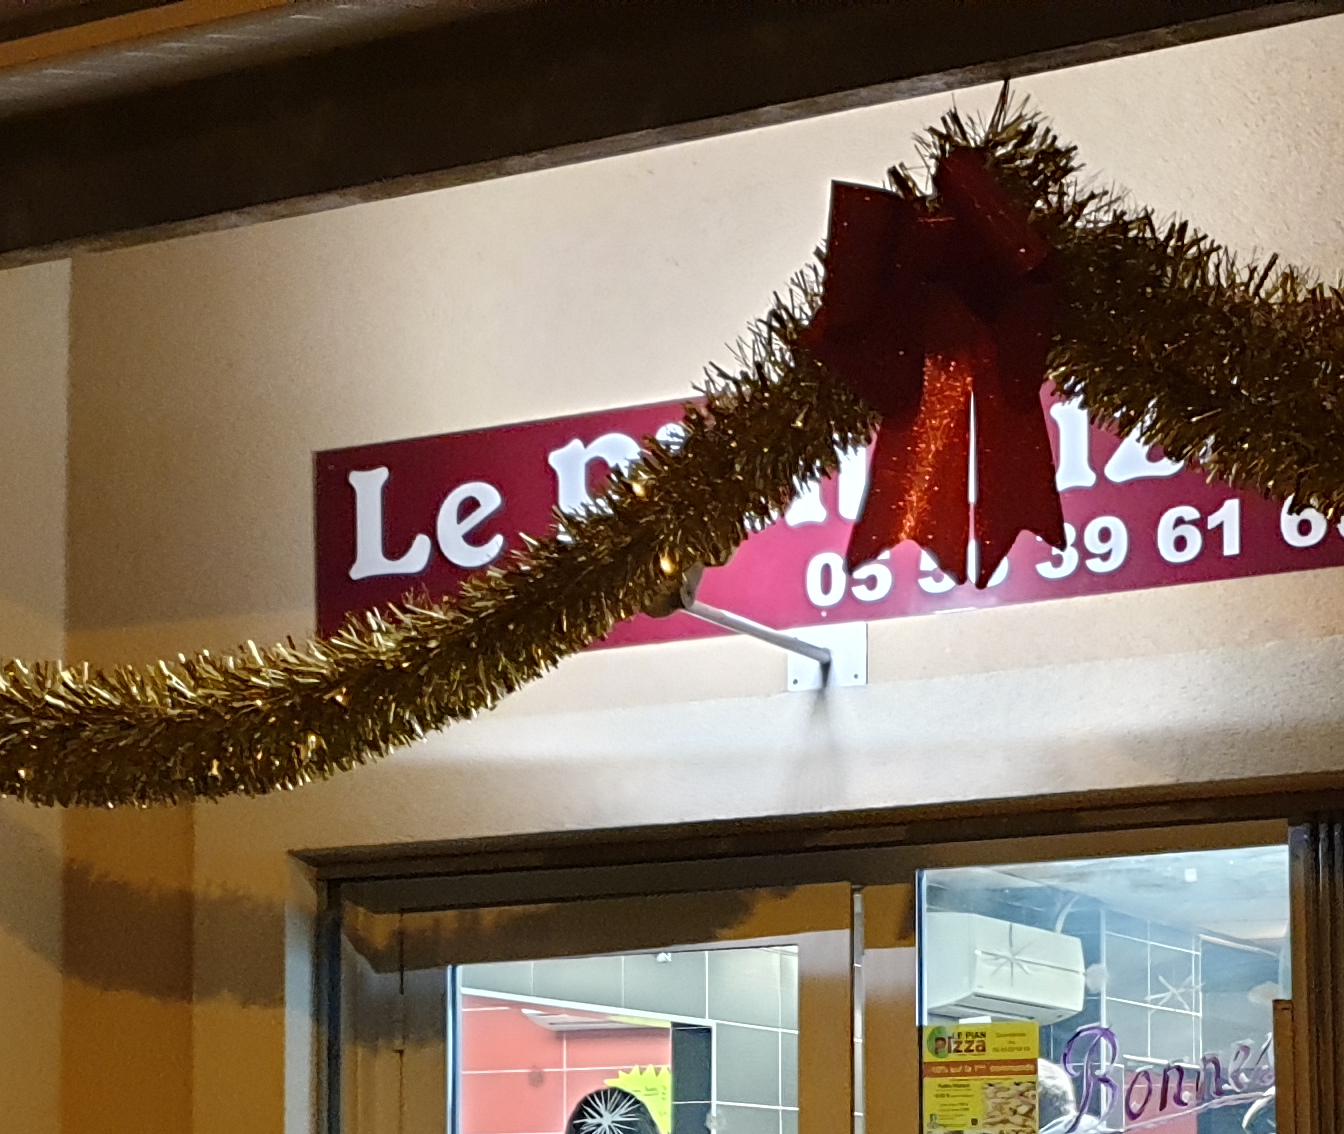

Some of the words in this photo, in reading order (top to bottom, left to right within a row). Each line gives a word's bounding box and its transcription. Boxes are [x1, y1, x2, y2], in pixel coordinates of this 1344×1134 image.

[348, 466, 503, 580] Le
[807, 550, 892, 606] 05
[1036, 521, 1128, 579] 39
[1157, 499, 1240, 563] 61
